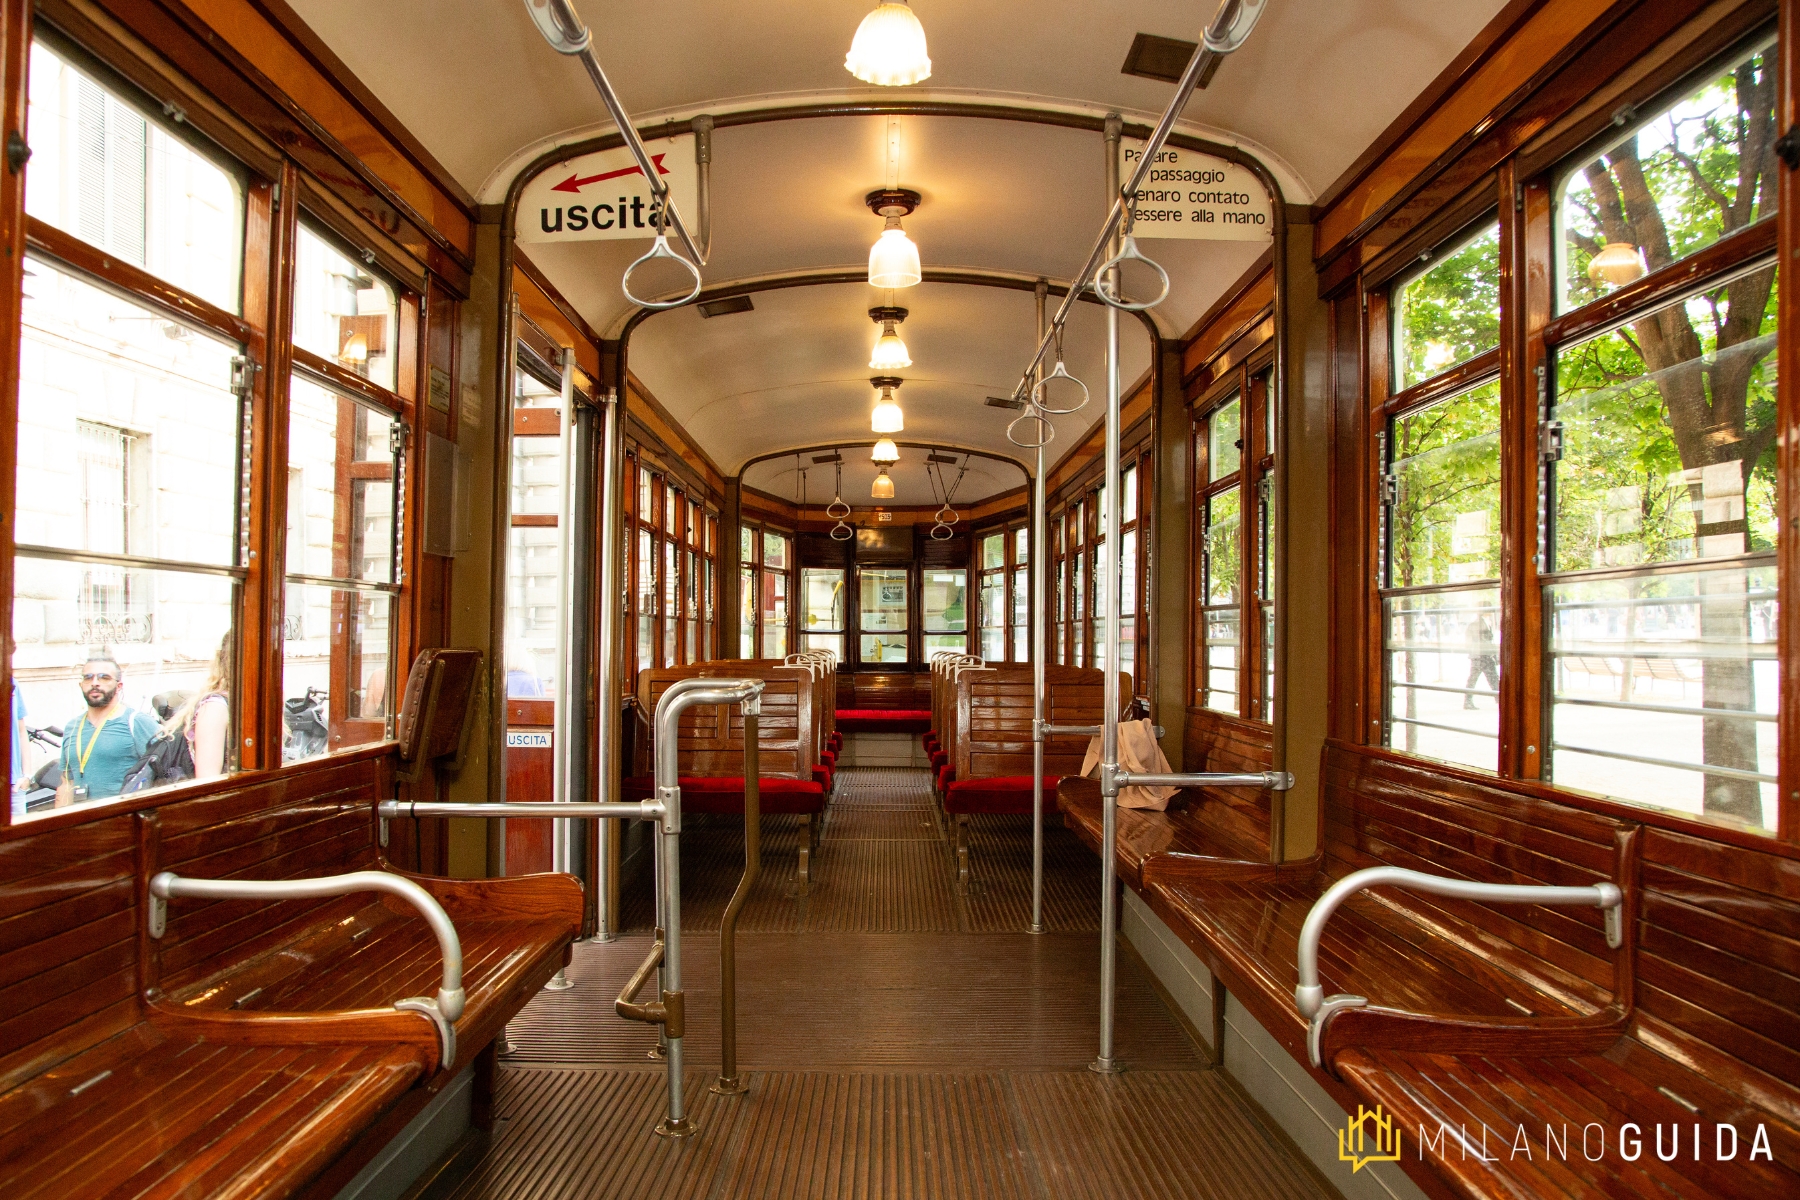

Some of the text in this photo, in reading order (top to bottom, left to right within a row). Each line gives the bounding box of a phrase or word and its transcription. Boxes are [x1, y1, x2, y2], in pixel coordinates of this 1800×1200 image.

[1124, 149, 1178, 163] Paare
[1150, 168, 1225, 184] passaggio
[1136, 189, 1250, 204] enaro contato
[540, 196, 672, 233] uscita
[1134, 208, 1265, 224] essere alla mano
[508, 735, 547, 745] USCITA
